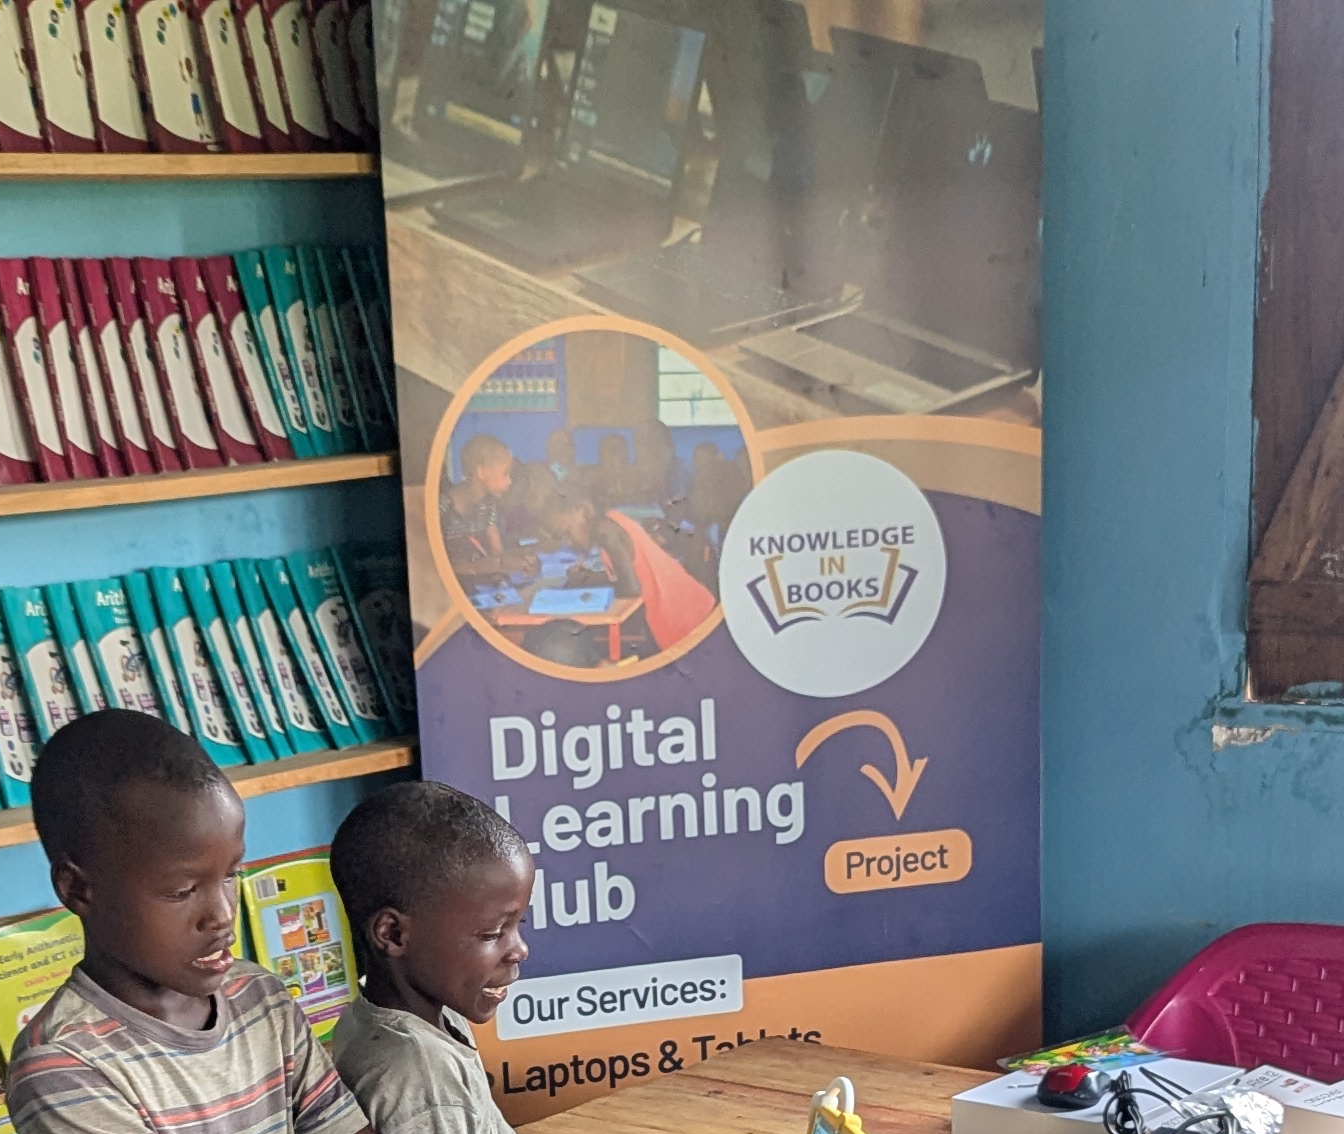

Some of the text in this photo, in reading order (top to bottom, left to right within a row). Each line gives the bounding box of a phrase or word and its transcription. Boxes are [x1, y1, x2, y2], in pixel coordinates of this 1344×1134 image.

[749, 525, 915, 557] KNOWLEDGE
[819, 555, 845, 576] IN
[786, 577, 880, 604] BOOKS
[489, 698, 717, 790] Digital
[844, 844, 950, 881] Project
[31, 957, 49, 970] and
[52, 951, 67, 964] ICT
[512, 976, 728, 1025] Our Services:
[502, 1051, 651, 1097] Laptops
[658, 1040, 685, 1074] &
